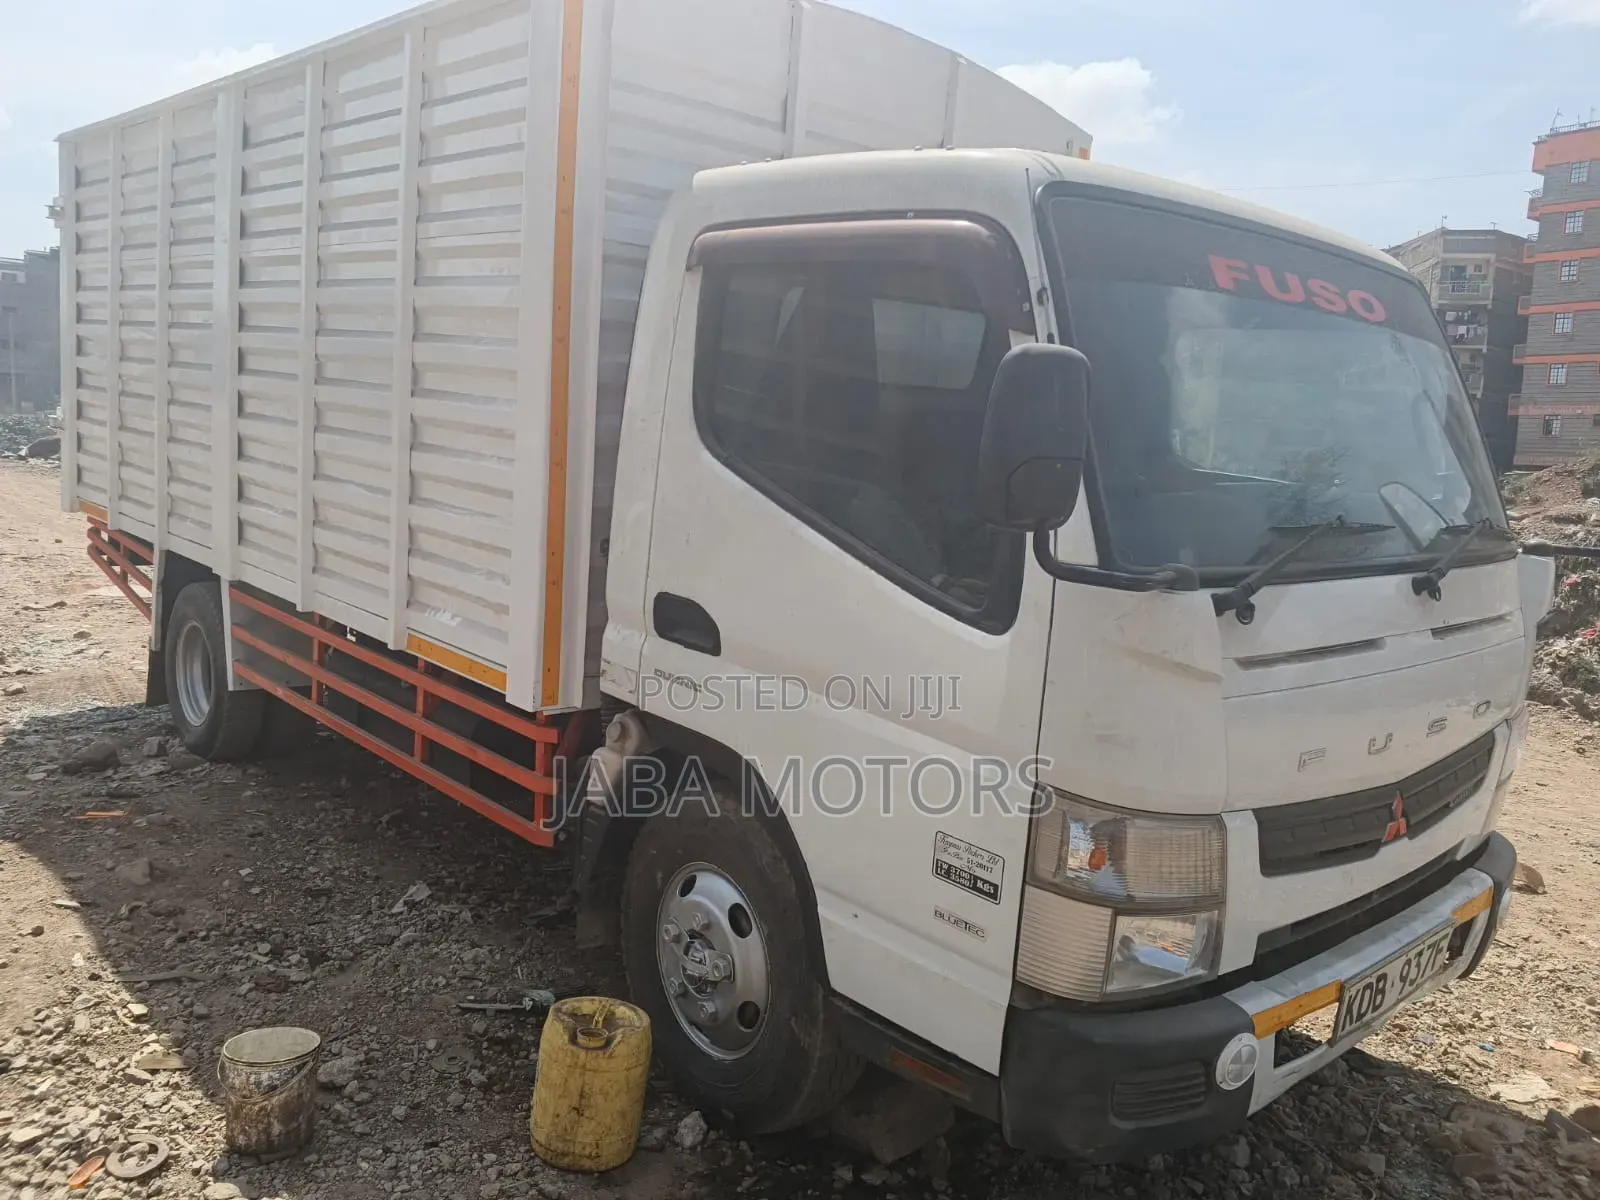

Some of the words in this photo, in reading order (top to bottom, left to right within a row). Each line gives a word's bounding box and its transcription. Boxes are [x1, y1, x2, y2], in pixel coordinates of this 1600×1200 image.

[1207, 252, 1386, 323] FUSO
[1297, 699, 1492, 773] FUSO
[976, 879, 995, 894] Kgs
[1340, 971, 1389, 1033] KDB
